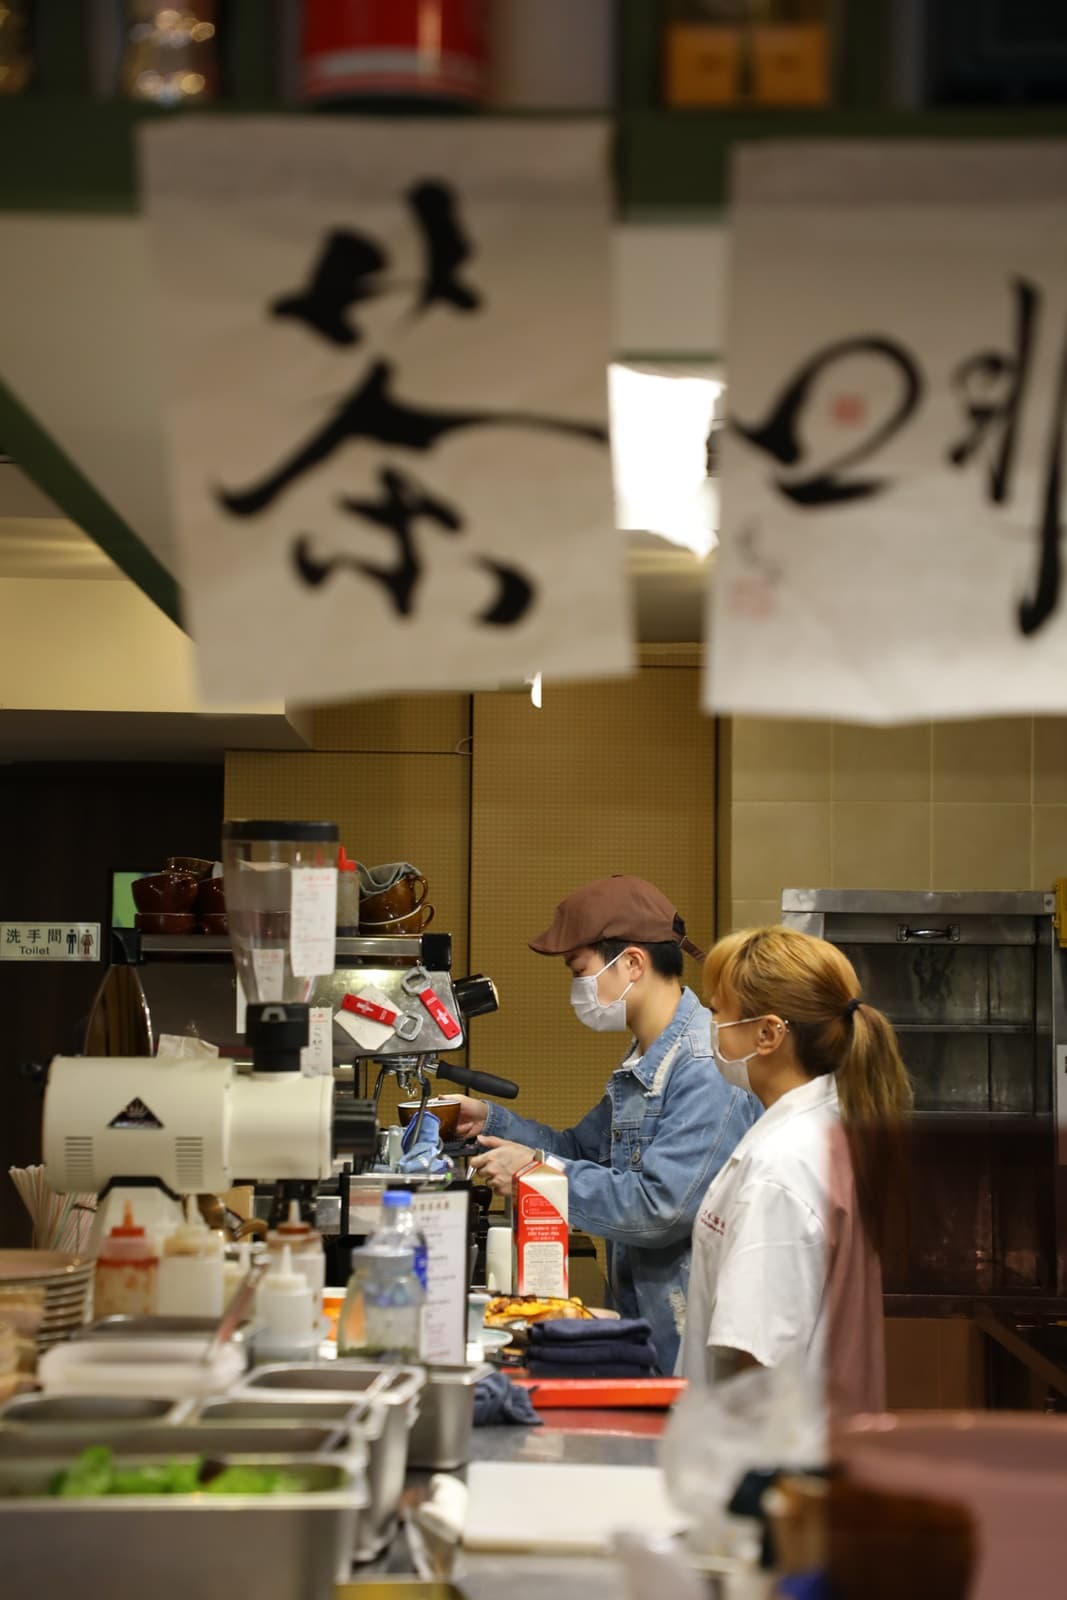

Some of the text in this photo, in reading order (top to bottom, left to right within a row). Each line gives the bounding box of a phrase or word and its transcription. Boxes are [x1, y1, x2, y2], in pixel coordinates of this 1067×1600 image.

[6, 928, 62, 944] 洗手間
[19, 946, 50, 955] Toilet
